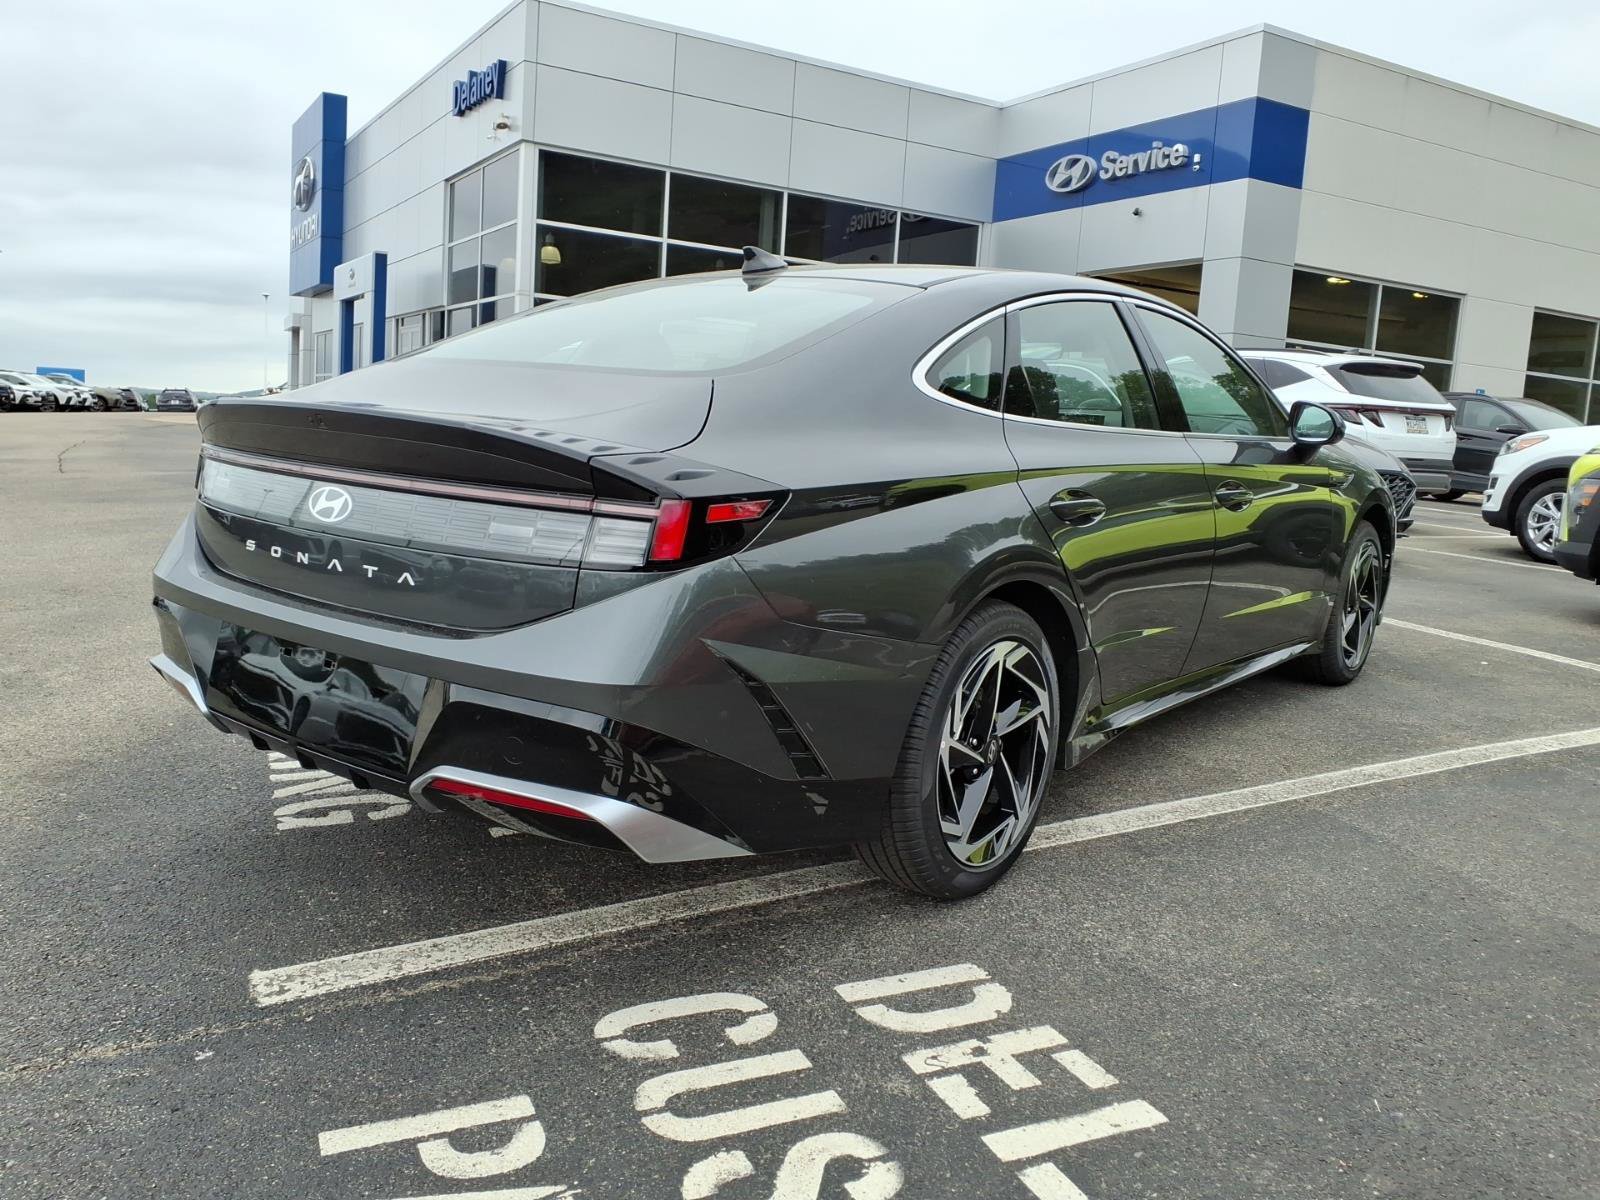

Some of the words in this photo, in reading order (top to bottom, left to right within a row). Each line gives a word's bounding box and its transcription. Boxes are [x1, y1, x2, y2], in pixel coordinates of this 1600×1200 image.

[453, 59, 506, 117] Delaney
[1099, 141, 1188, 180] Service
[245, 539, 415, 586] SONATA
